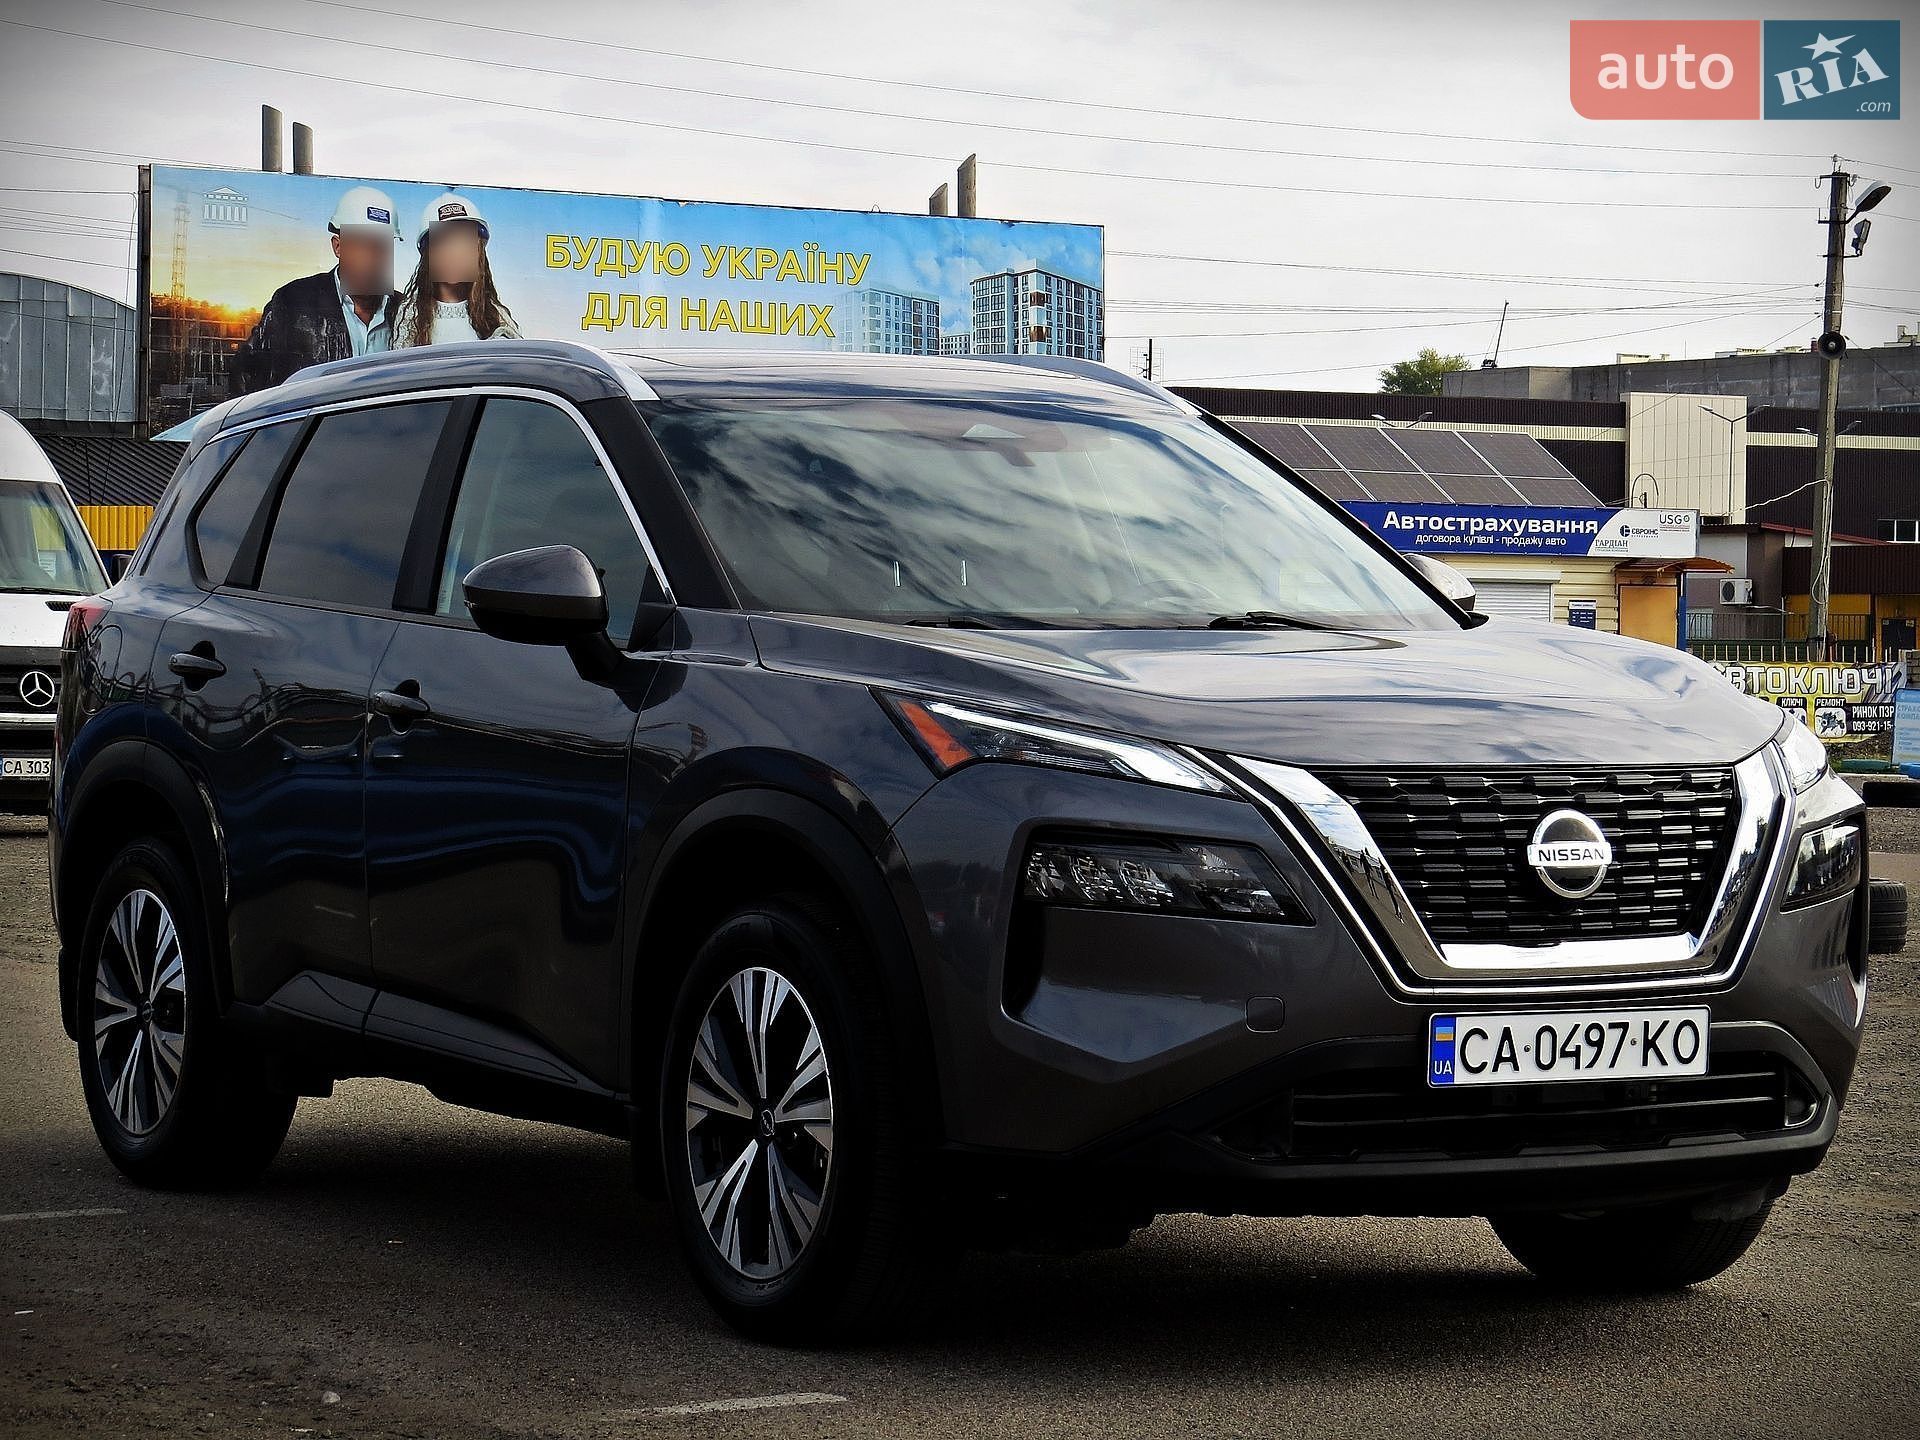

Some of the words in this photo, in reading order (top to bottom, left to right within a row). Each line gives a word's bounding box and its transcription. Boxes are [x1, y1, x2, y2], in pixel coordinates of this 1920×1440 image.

[546, 234, 691, 278] БУДУЮ
[700, 241, 871, 286] УКРАЇНУ
[581, 292, 668, 331] ДЛЯ
[681, 297, 836, 337] НАШИХ
[1383, 511, 1598, 535] Автострахування
[1659, 514, 1683, 525] USG
[1415, 534, 1462, 546] договора
[1463, 535, 1494, 546] купівлі
[1501, 536, 1544, 548] продажу
[1545, 538, 1567, 547] авто
[1595, 539, 1628, 548] ГАРДІАН
[1713, 665, 1893, 695] ВТОКЛЮЧІ
[1781, 698, 1803, 707] КЛЮЧІ
[1816, 698, 1846, 707] РЕМОНТ
[1852, 706, 1877, 719] РИНОК
[4, 760, 23, 774] CA
[1538, 848, 1604, 861] NISSAN
[1459, 1026, 1520, 1074] CA
[1535, 1021, 1630, 1071] 0497
[1642, 1019, 1700, 1067] KO
[1434, 1060, 1453, 1075] UA
